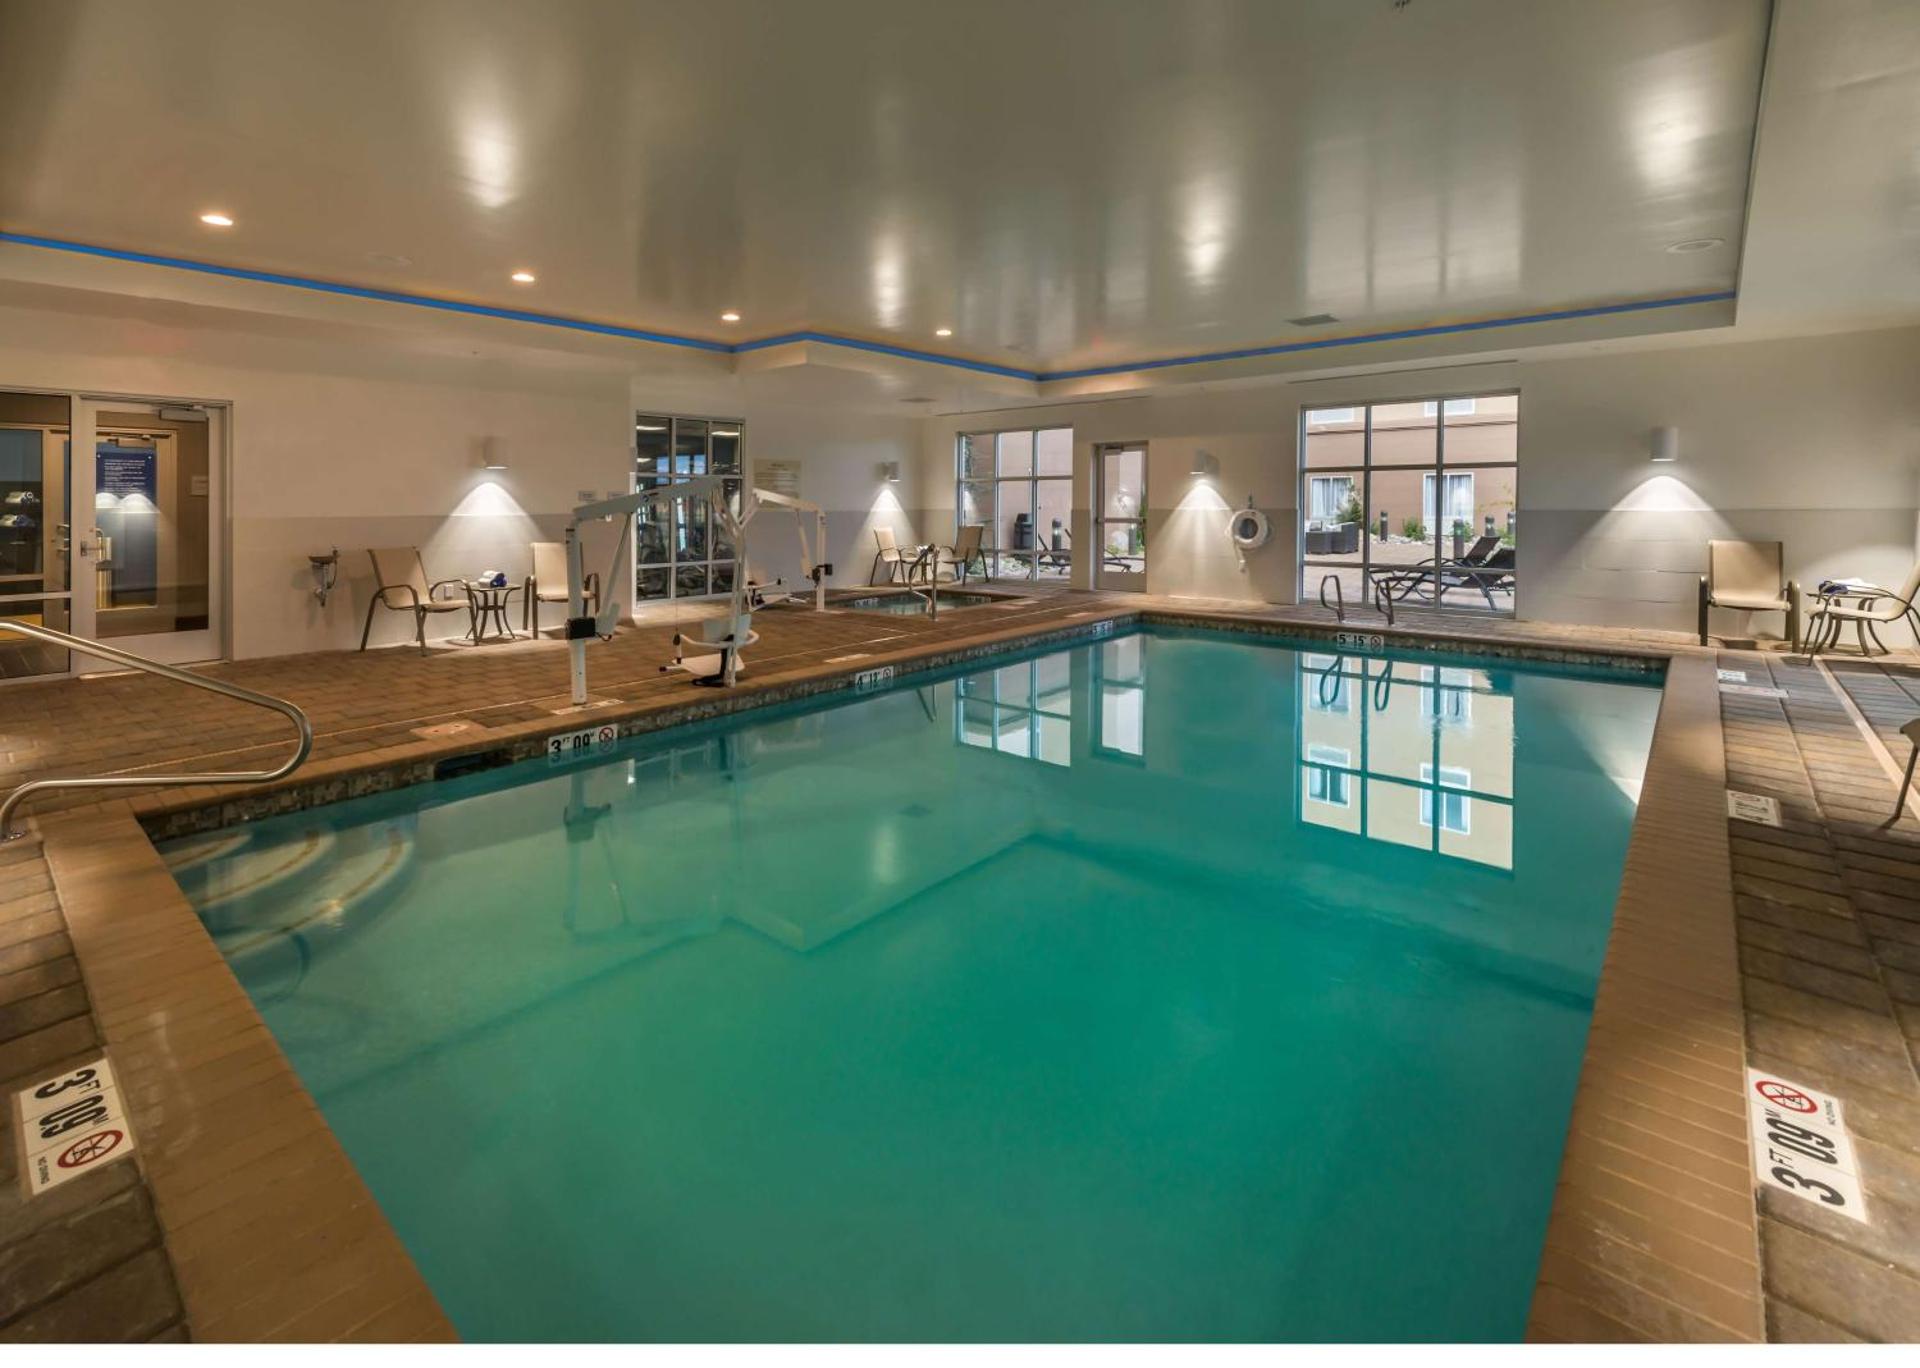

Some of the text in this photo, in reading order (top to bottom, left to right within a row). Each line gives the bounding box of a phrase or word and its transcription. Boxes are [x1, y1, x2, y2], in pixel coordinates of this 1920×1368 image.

[34, 1068, 97, 1099] 3
[78, 1079, 102, 1095] FT
[1768, 1147, 1795, 1169] FT
[1771, 1166, 1846, 1207] 3
